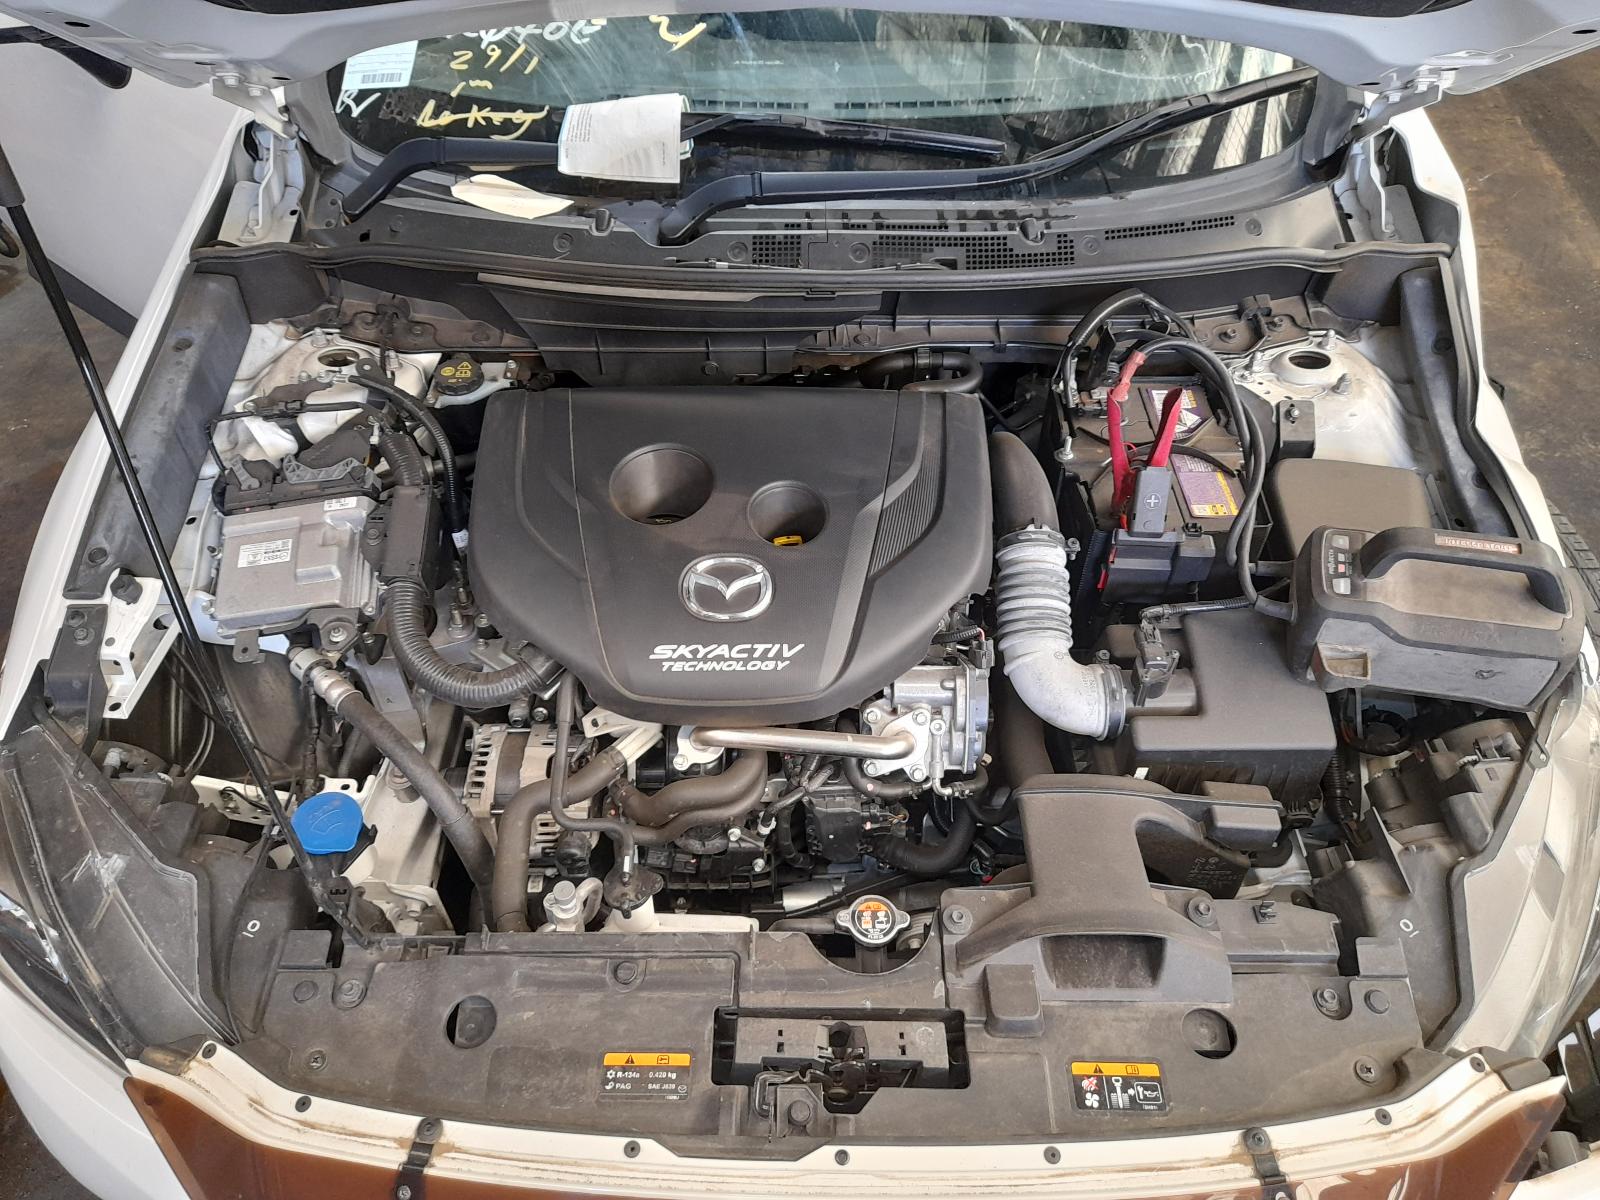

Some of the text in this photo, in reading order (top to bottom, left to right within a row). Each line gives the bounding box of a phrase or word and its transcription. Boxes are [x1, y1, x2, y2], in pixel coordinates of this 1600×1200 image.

[649, 643, 805, 660] SKYACTIV
[661, 660, 790, 672] TECHNOLOGY
[668, 1071, 677, 1080] kg
